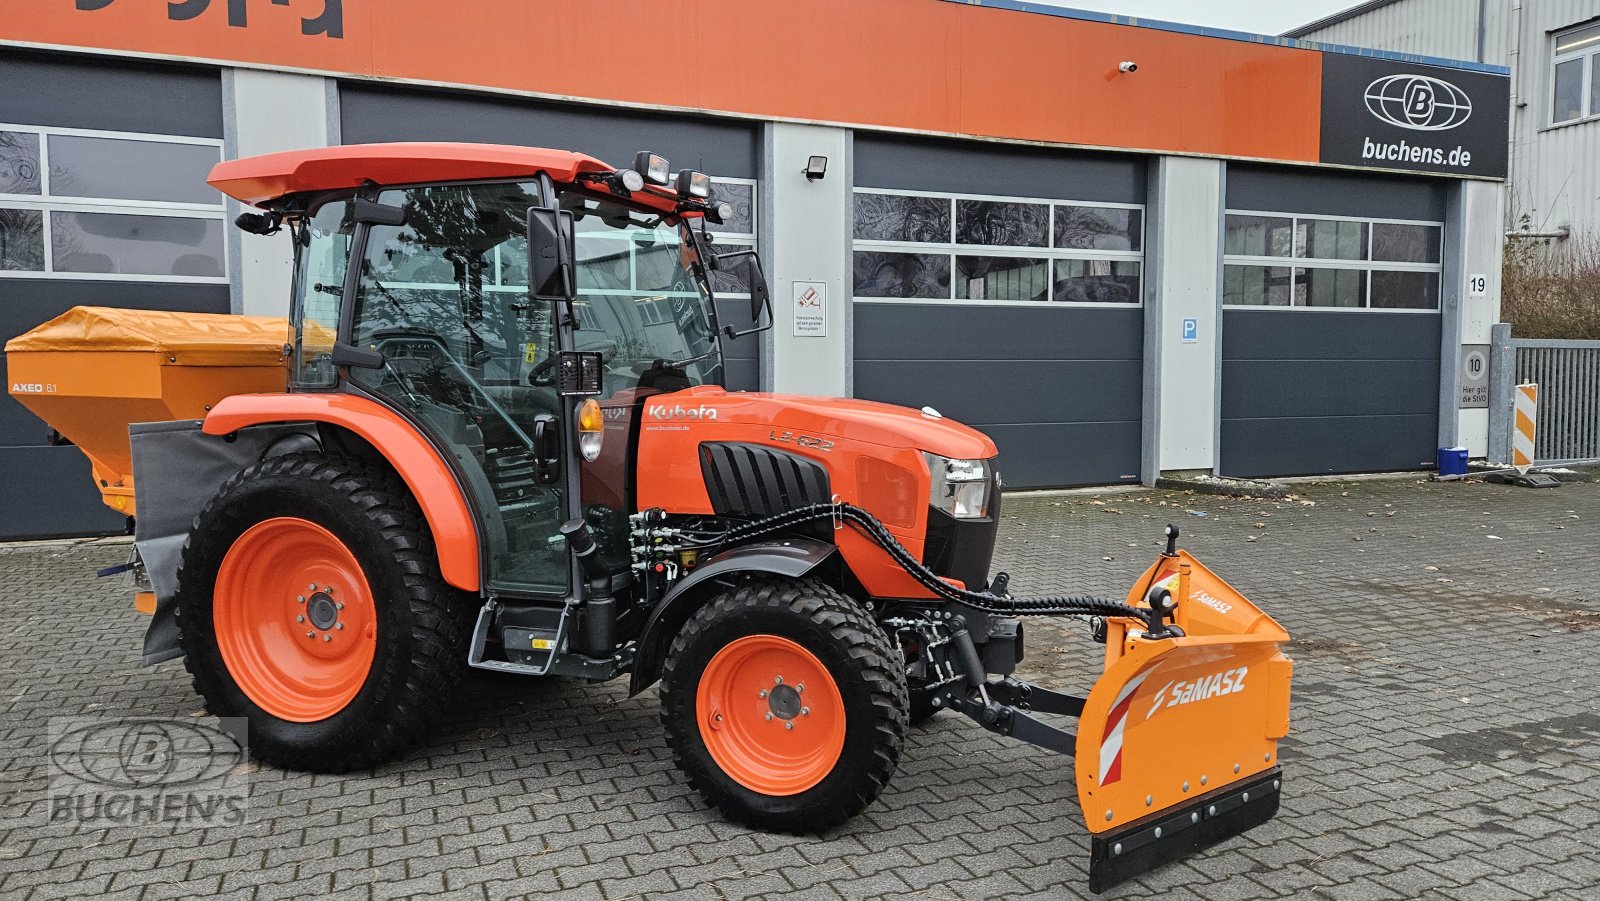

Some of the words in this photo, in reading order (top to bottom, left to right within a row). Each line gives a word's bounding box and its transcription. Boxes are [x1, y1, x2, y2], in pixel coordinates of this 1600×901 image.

[1362, 137, 1471, 167] buchens.de
[1470, 277, 1485, 292] 19
[1185, 320, 1195, 337] P
[1470, 359, 1481, 372] 10
[12, 383, 43, 393] AXEO
[1462, 385, 1475, 393] Hier
[648, 404, 718, 421] Kubota
[1197, 592, 1233, 614] SaMASZ
[1166, 665, 1249, 709] SaMASZ
